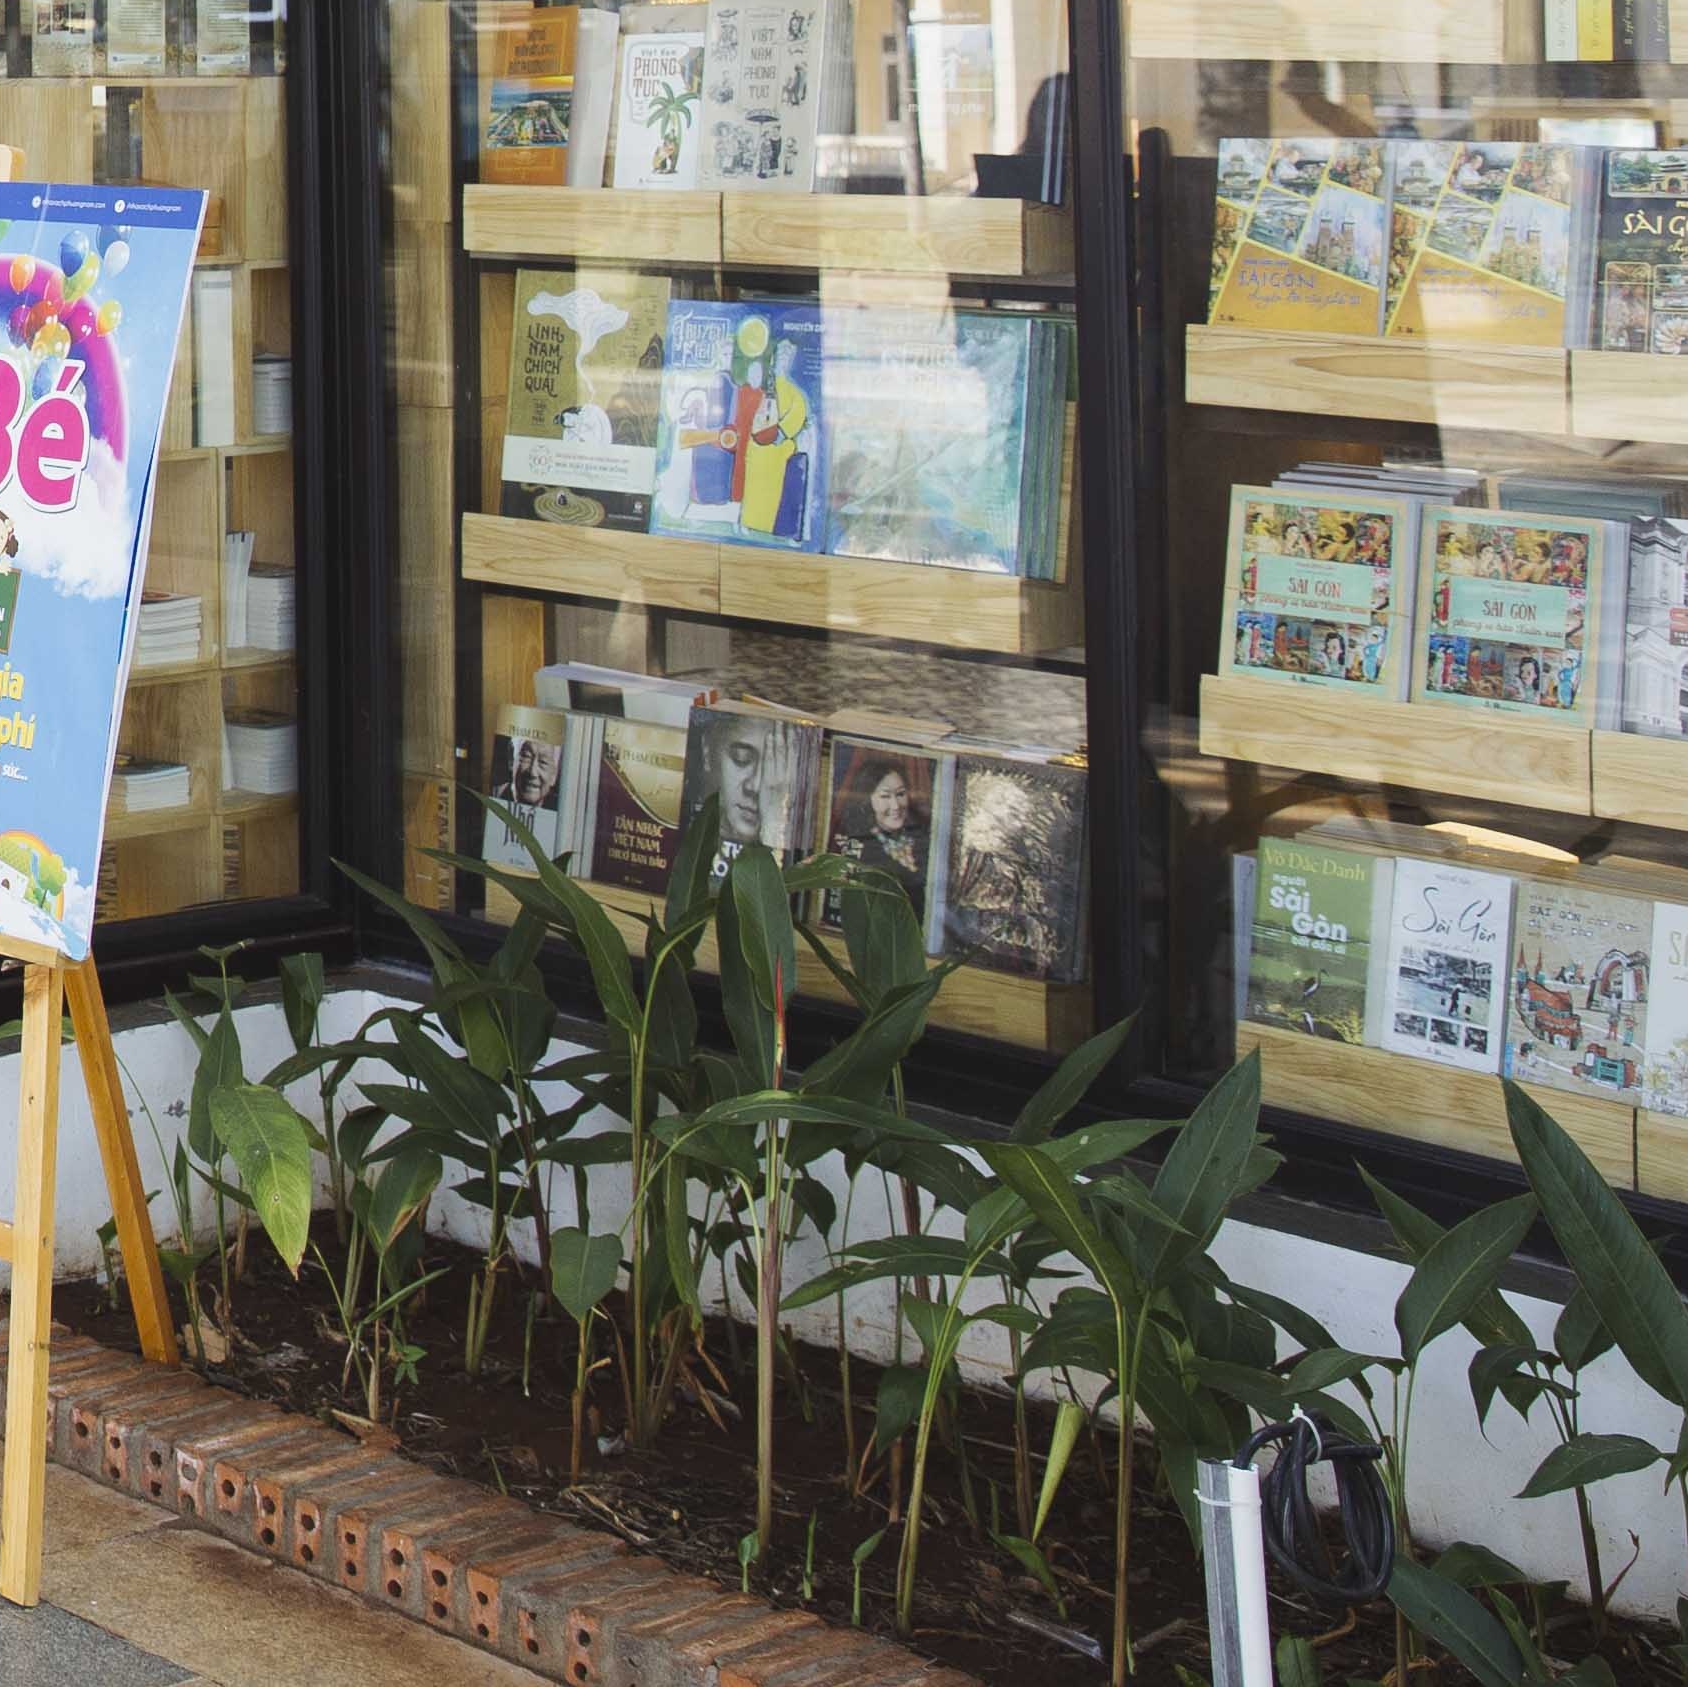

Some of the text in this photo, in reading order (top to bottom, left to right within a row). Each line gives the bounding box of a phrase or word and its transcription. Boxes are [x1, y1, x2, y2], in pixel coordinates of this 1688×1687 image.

[633, 57, 678, 77] PHONG
[1623, 208, 1663, 234] SÀI
[528, 340, 561, 356] NAM
[1323, 858, 1365, 881] Danh
[1269, 886, 1311, 913] Sài
[1291, 912, 1347, 942] Gòn
[1402, 886, 1452, 935] Sài
[1458, 899, 1497, 943] Gòn
